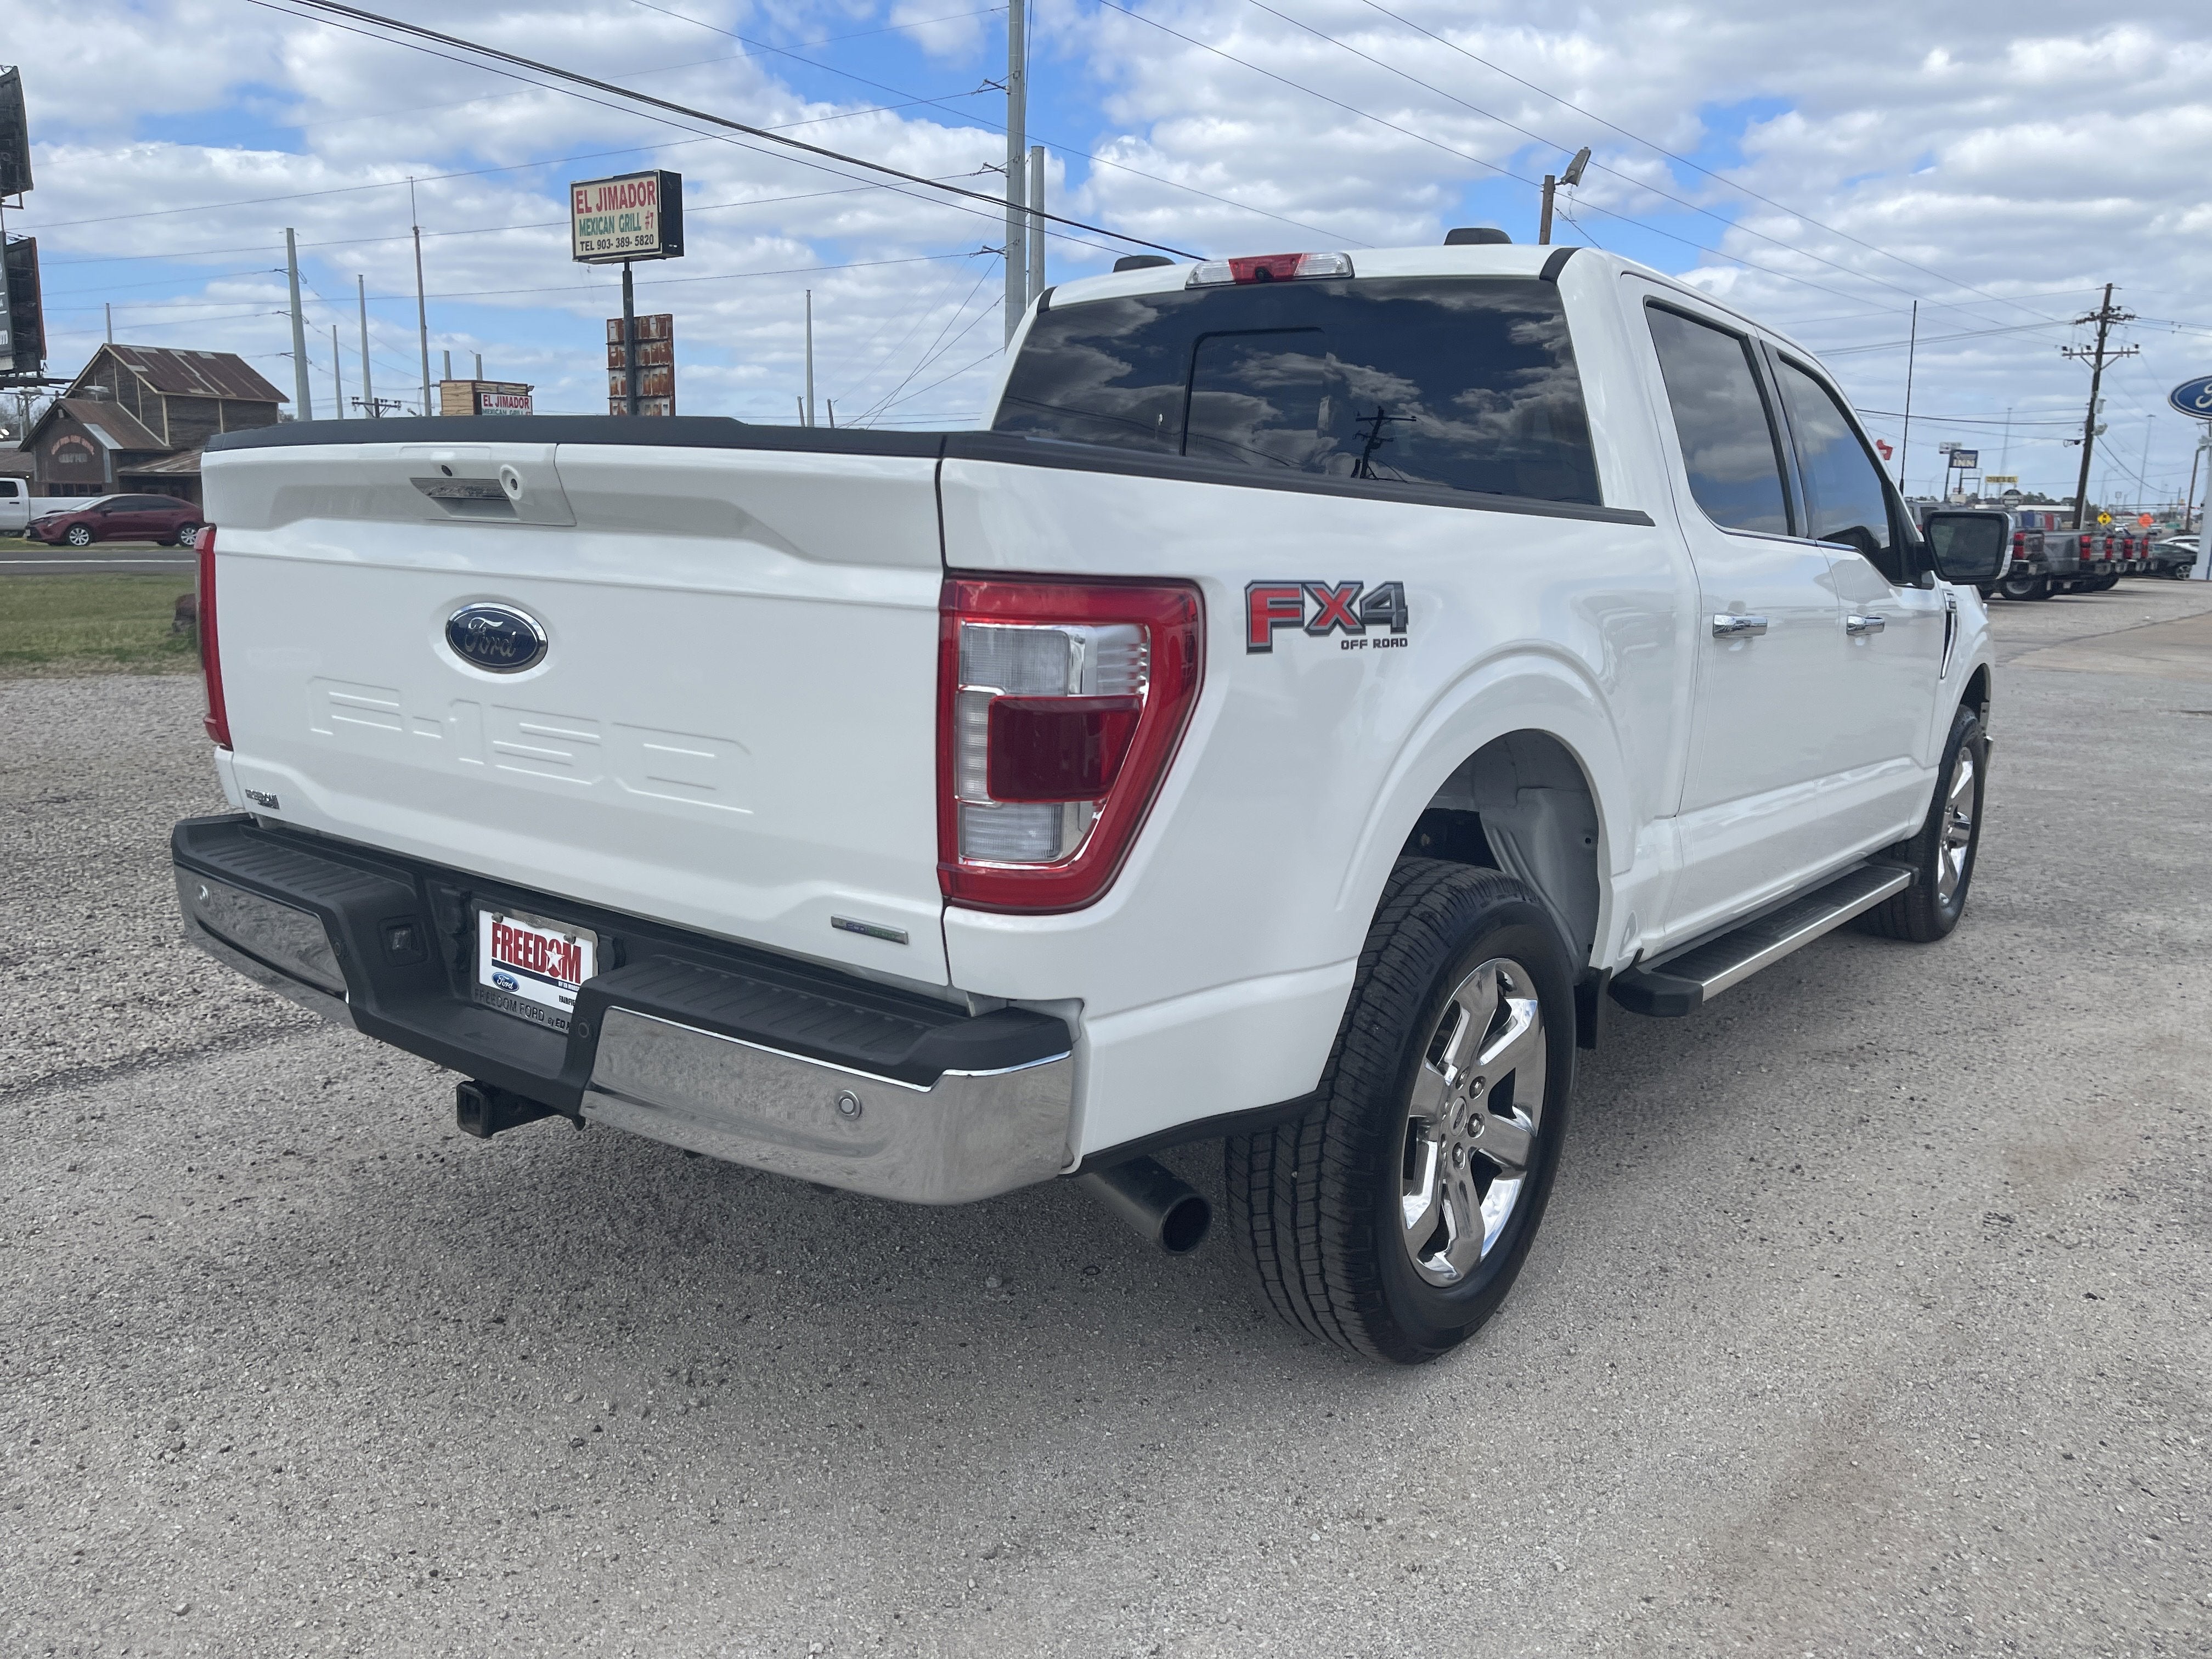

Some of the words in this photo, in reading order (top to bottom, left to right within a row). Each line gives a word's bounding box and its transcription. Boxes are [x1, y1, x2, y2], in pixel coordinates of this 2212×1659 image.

[575, 190, 592, 214] EL
[596, 180, 656, 212] JIMADOR
[579, 215, 615, 237] MEXICAN
[619, 212, 642, 233] GRILL
[580, 240, 595, 251] TEL
[483, 394, 493, 407] EL
[495, 395, 529, 409] JIMADOR
[1244, 579, 1409, 655] FX4
[1341, 639, 1368, 650] OFF
[1373, 637, 1408, 648] ROAD
[307, 675, 754, 814] F-150
[492, 922, 582, 984] FREEDOM
[496, 975, 514, 990] Ford
[474, 989, 517, 1013] FREEDOM
[520, 1002, 545, 1022] FORD
